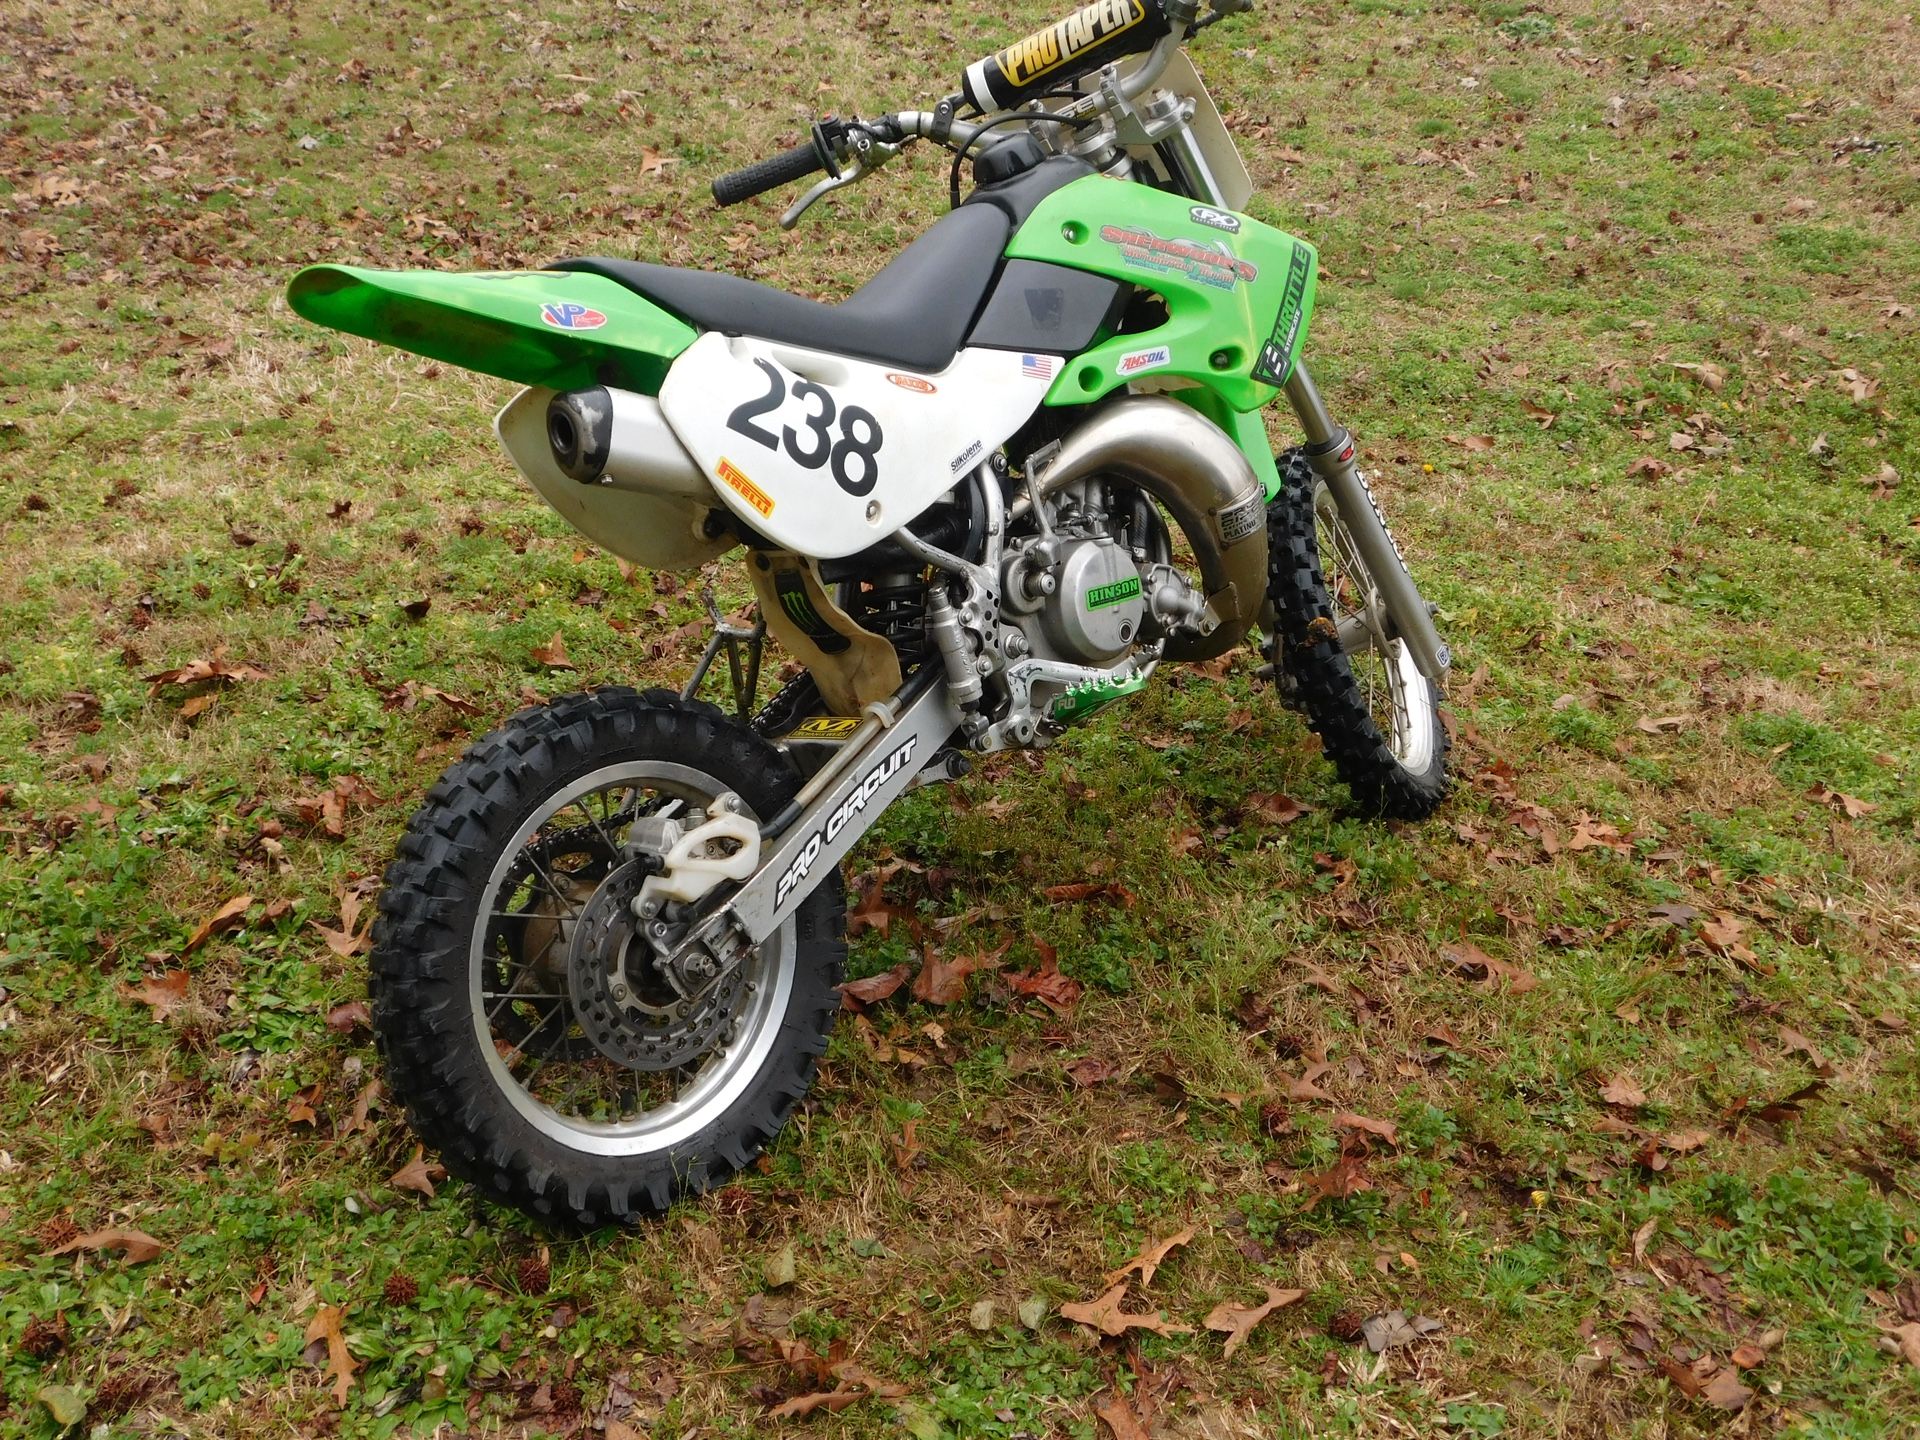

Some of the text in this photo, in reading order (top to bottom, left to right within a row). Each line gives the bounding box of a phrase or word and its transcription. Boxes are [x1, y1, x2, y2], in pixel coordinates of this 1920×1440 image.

[543, 303, 587, 328] VP
[1272, 244, 1308, 349] THROTTLE
[1284, 308, 1301, 353] SYNDICATE
[1122, 351, 1165, 370] AMSOIL
[726, 357, 883, 497] 238
[950, 439, 982, 471] Silkolene
[718, 461, 772, 514] PIRELLI
[1089, 579, 1139, 603] HINSON
[775, 735, 917, 909] PRO CIRCUIT
